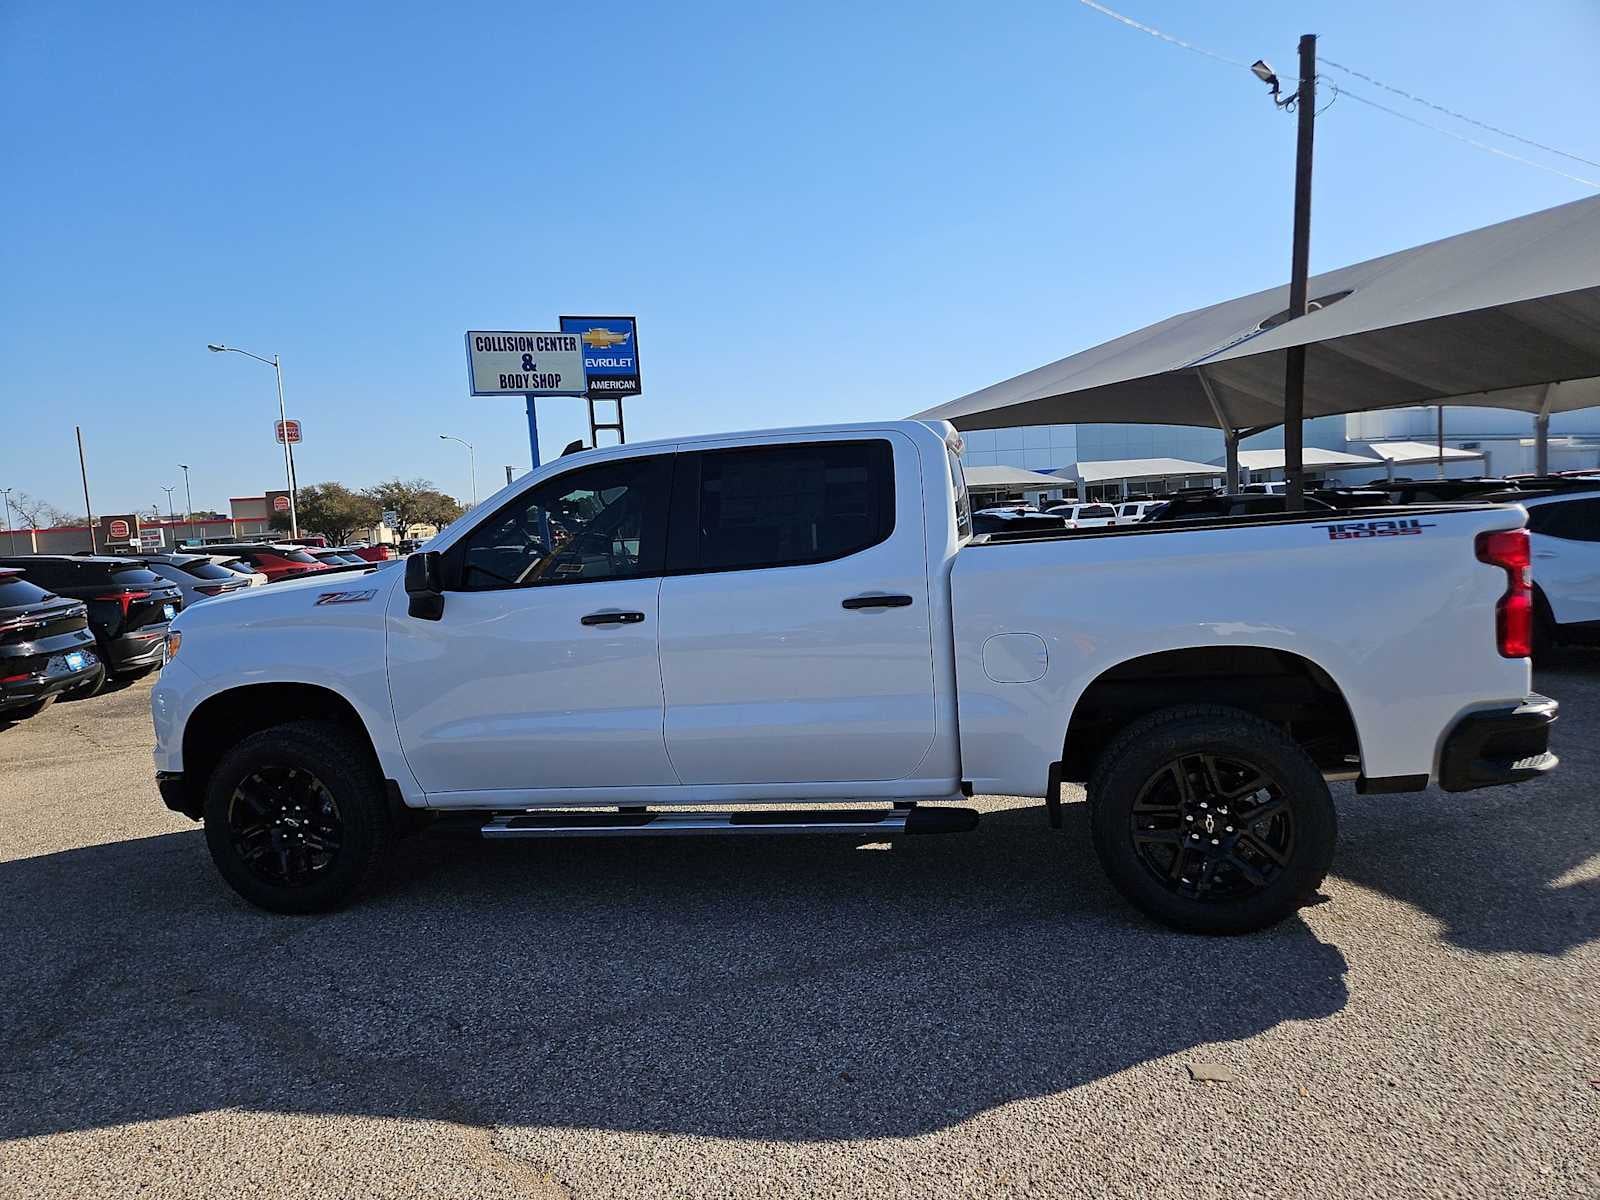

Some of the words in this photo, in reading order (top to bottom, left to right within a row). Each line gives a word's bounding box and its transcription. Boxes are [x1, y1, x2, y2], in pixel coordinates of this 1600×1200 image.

[475, 336, 534, 352] COLLISION
[536, 336, 577, 352] CENTER
[521, 353, 537, 372] &
[585, 358, 633, 368] EVROLET
[499, 374, 531, 389] BODY
[532, 373, 562, 389] SHOP
[590, 380, 636, 390] AMERICAN
[1312, 519, 1437, 532] TRAIL
[1328, 527, 1423, 540] BOSS
